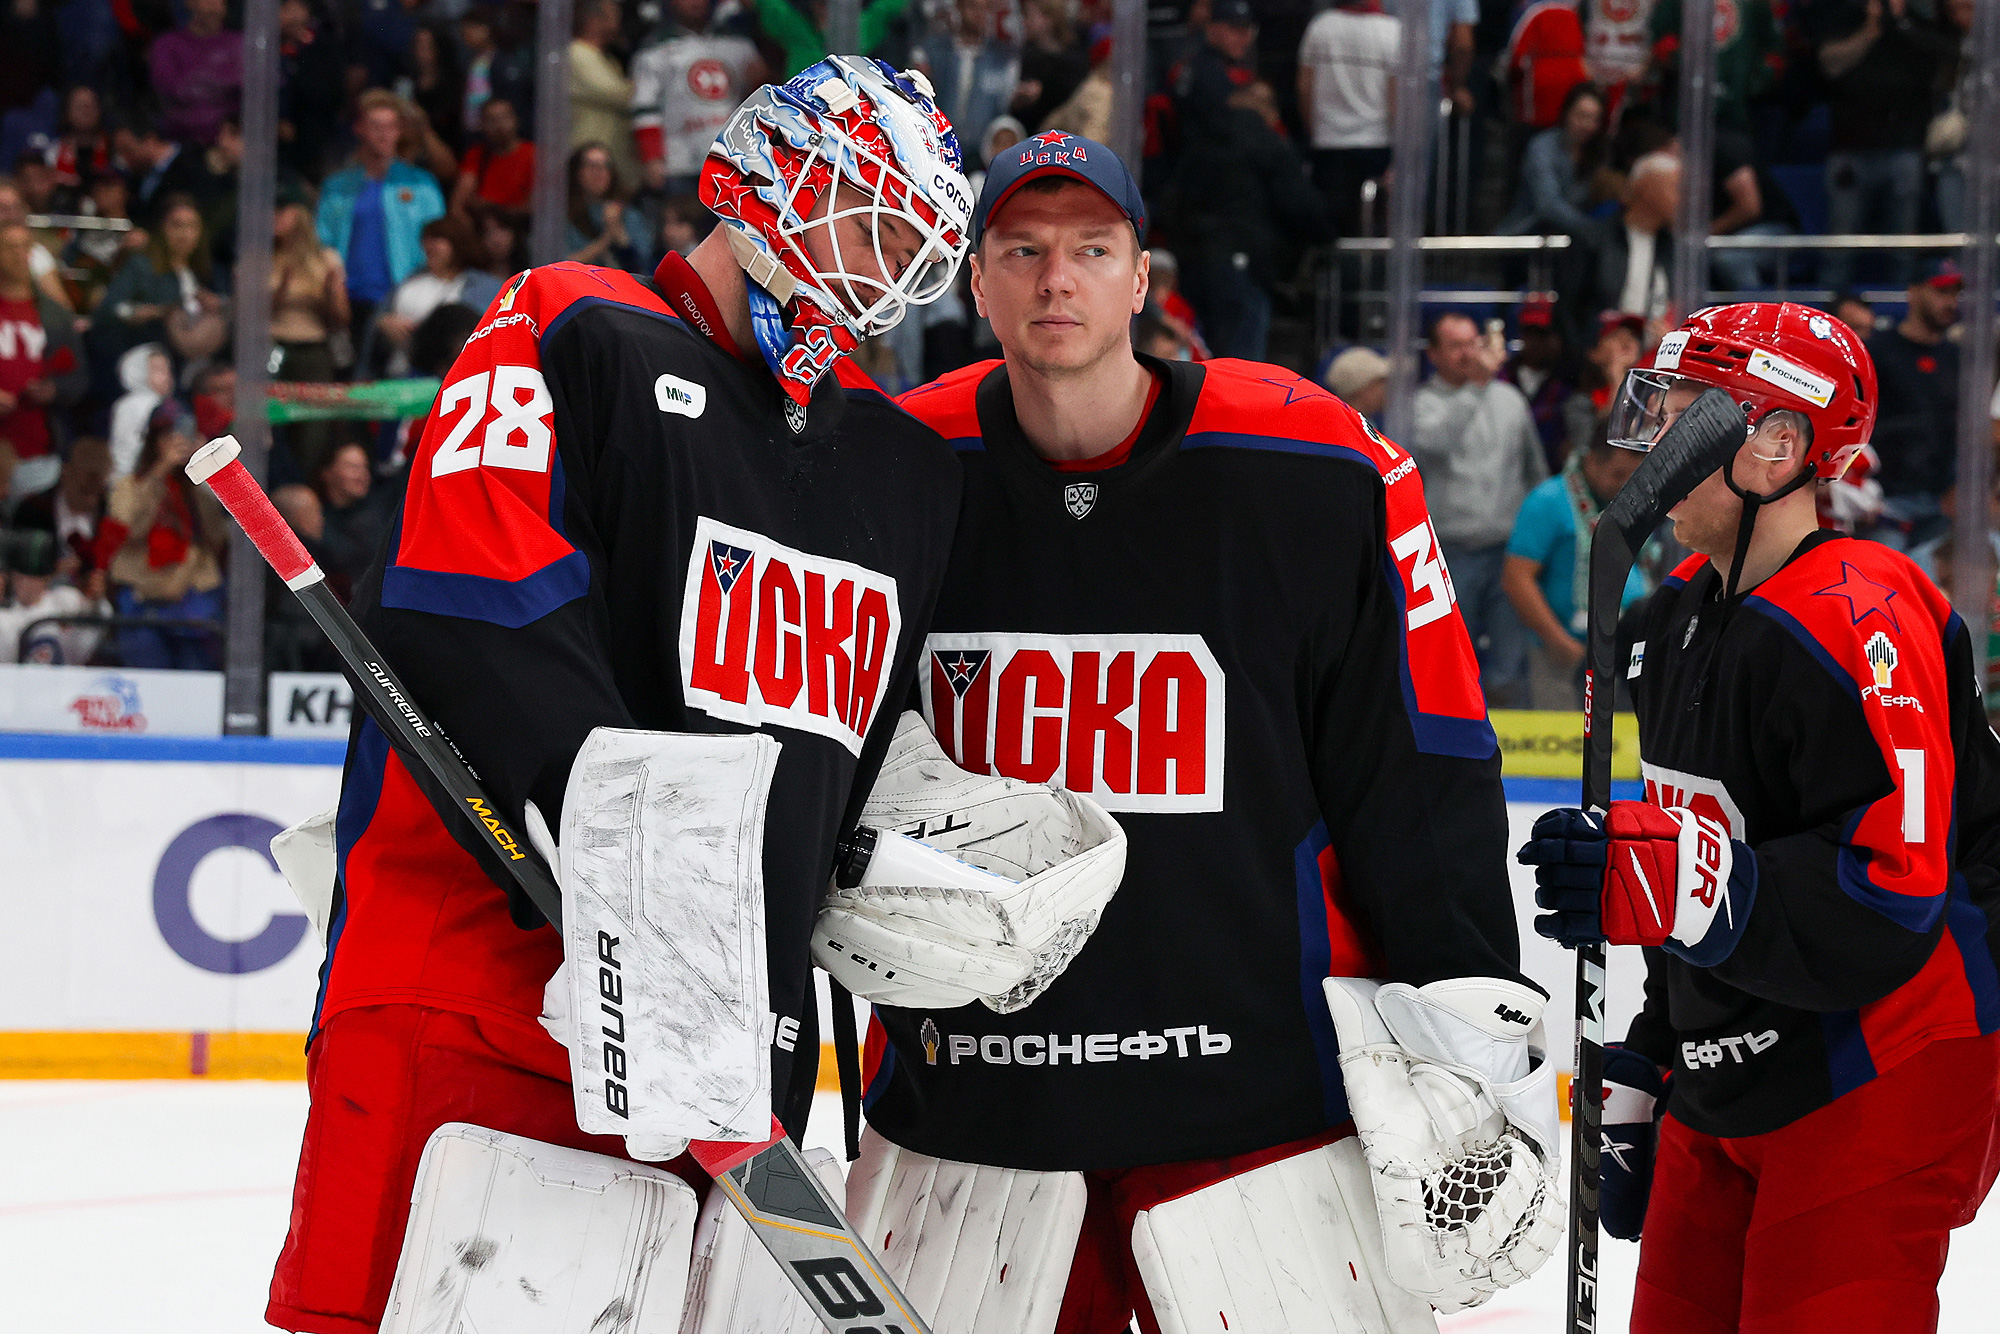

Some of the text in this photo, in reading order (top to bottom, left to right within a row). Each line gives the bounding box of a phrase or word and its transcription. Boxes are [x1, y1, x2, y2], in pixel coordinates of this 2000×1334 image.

[738, 118, 759, 154] ЦСКА
[1020, 146, 1087, 166] ЦСКА
[680, 291, 714, 338] FEDOTOV
[1770, 365, 1822, 395] РОСНЕФТЬ
[431, 364, 555, 479] 28
[689, 539, 891, 739] ЦСКА
[364, 660, 432, 738] SUPREME
[930, 649, 1207, 796] ЦСКА
[1584, 673, 1594, 735] CCM
[1894, 748, 1925, 844] 1
[465, 797, 526, 861] MACH
[597, 929, 630, 1121] BAUER
[948, 1024, 1232, 1066] РОСНЕФТЬ
